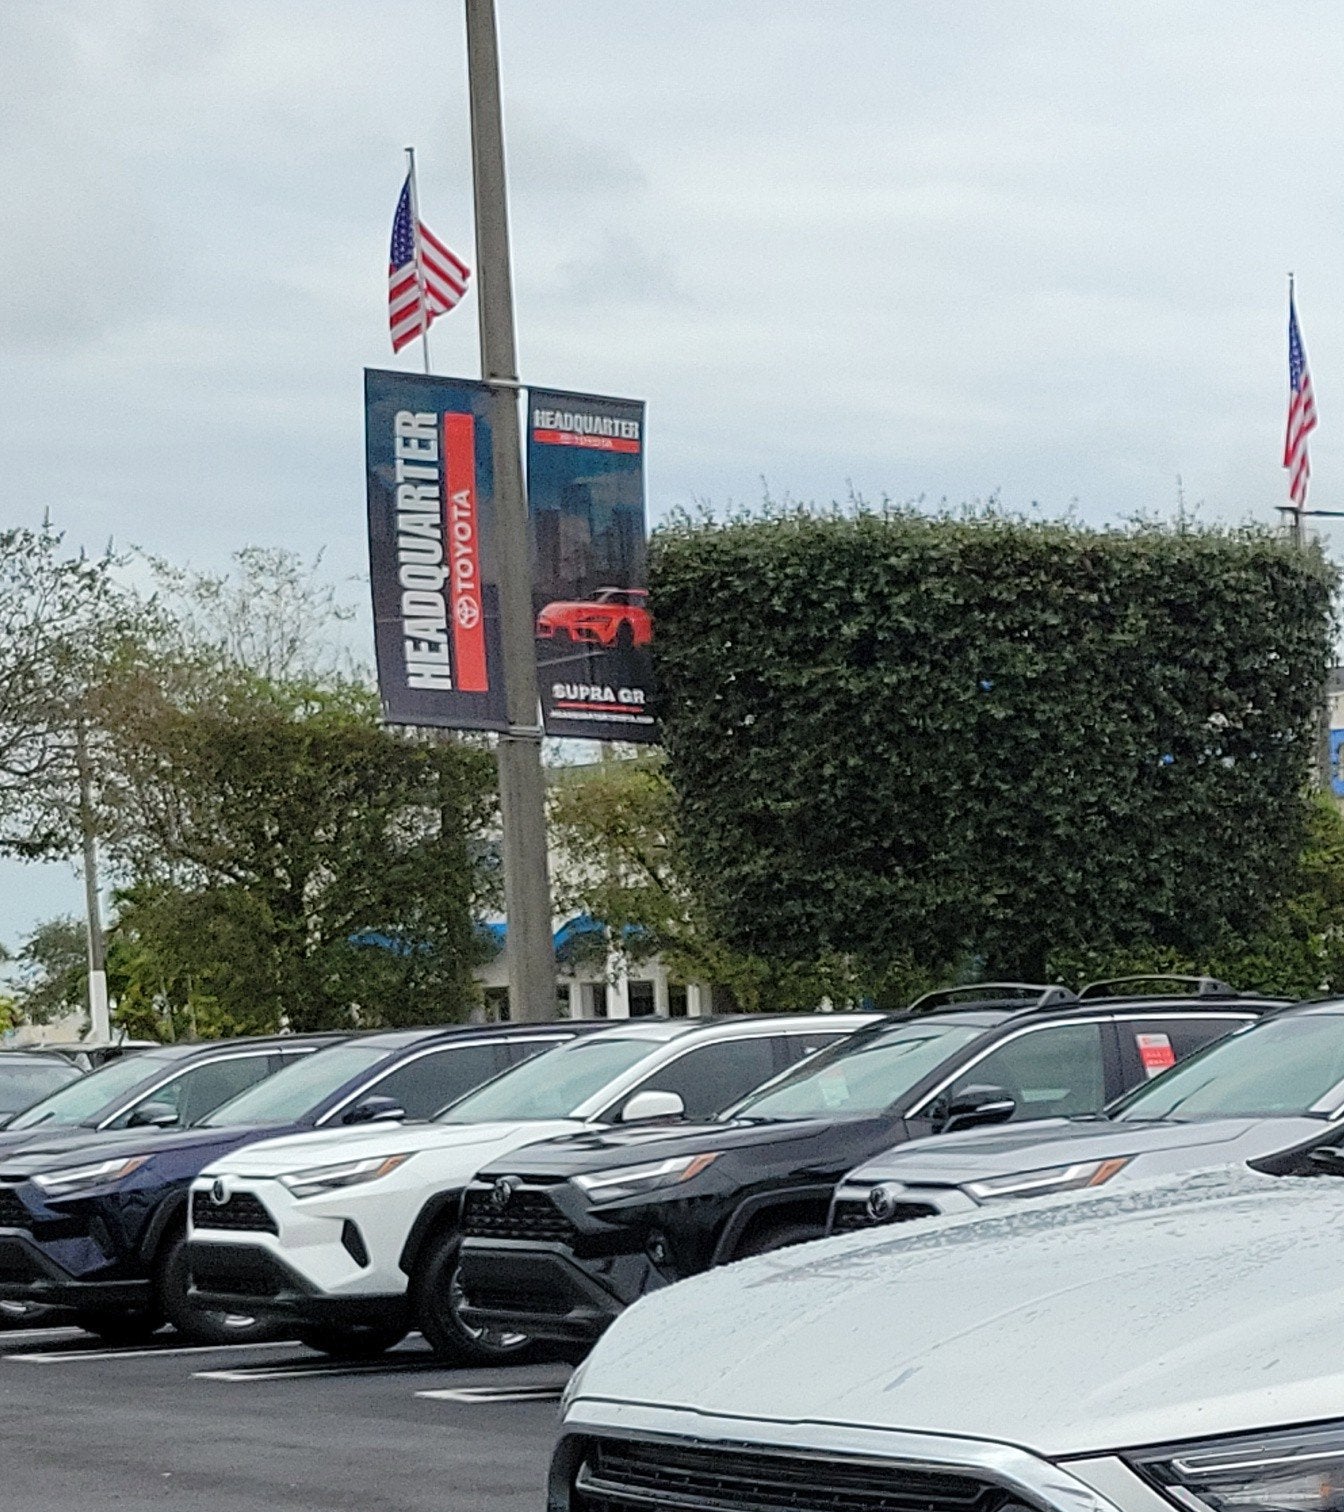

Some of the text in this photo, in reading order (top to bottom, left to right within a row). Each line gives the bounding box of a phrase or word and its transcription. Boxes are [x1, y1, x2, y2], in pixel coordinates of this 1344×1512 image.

[533, 409, 639, 439] HEADQUARTER
[395, 410, 452, 690] HEADQUARTER
[453, 489, 474, 592] TOYOTA
[552, 683, 646, 704] SUPRA GR
